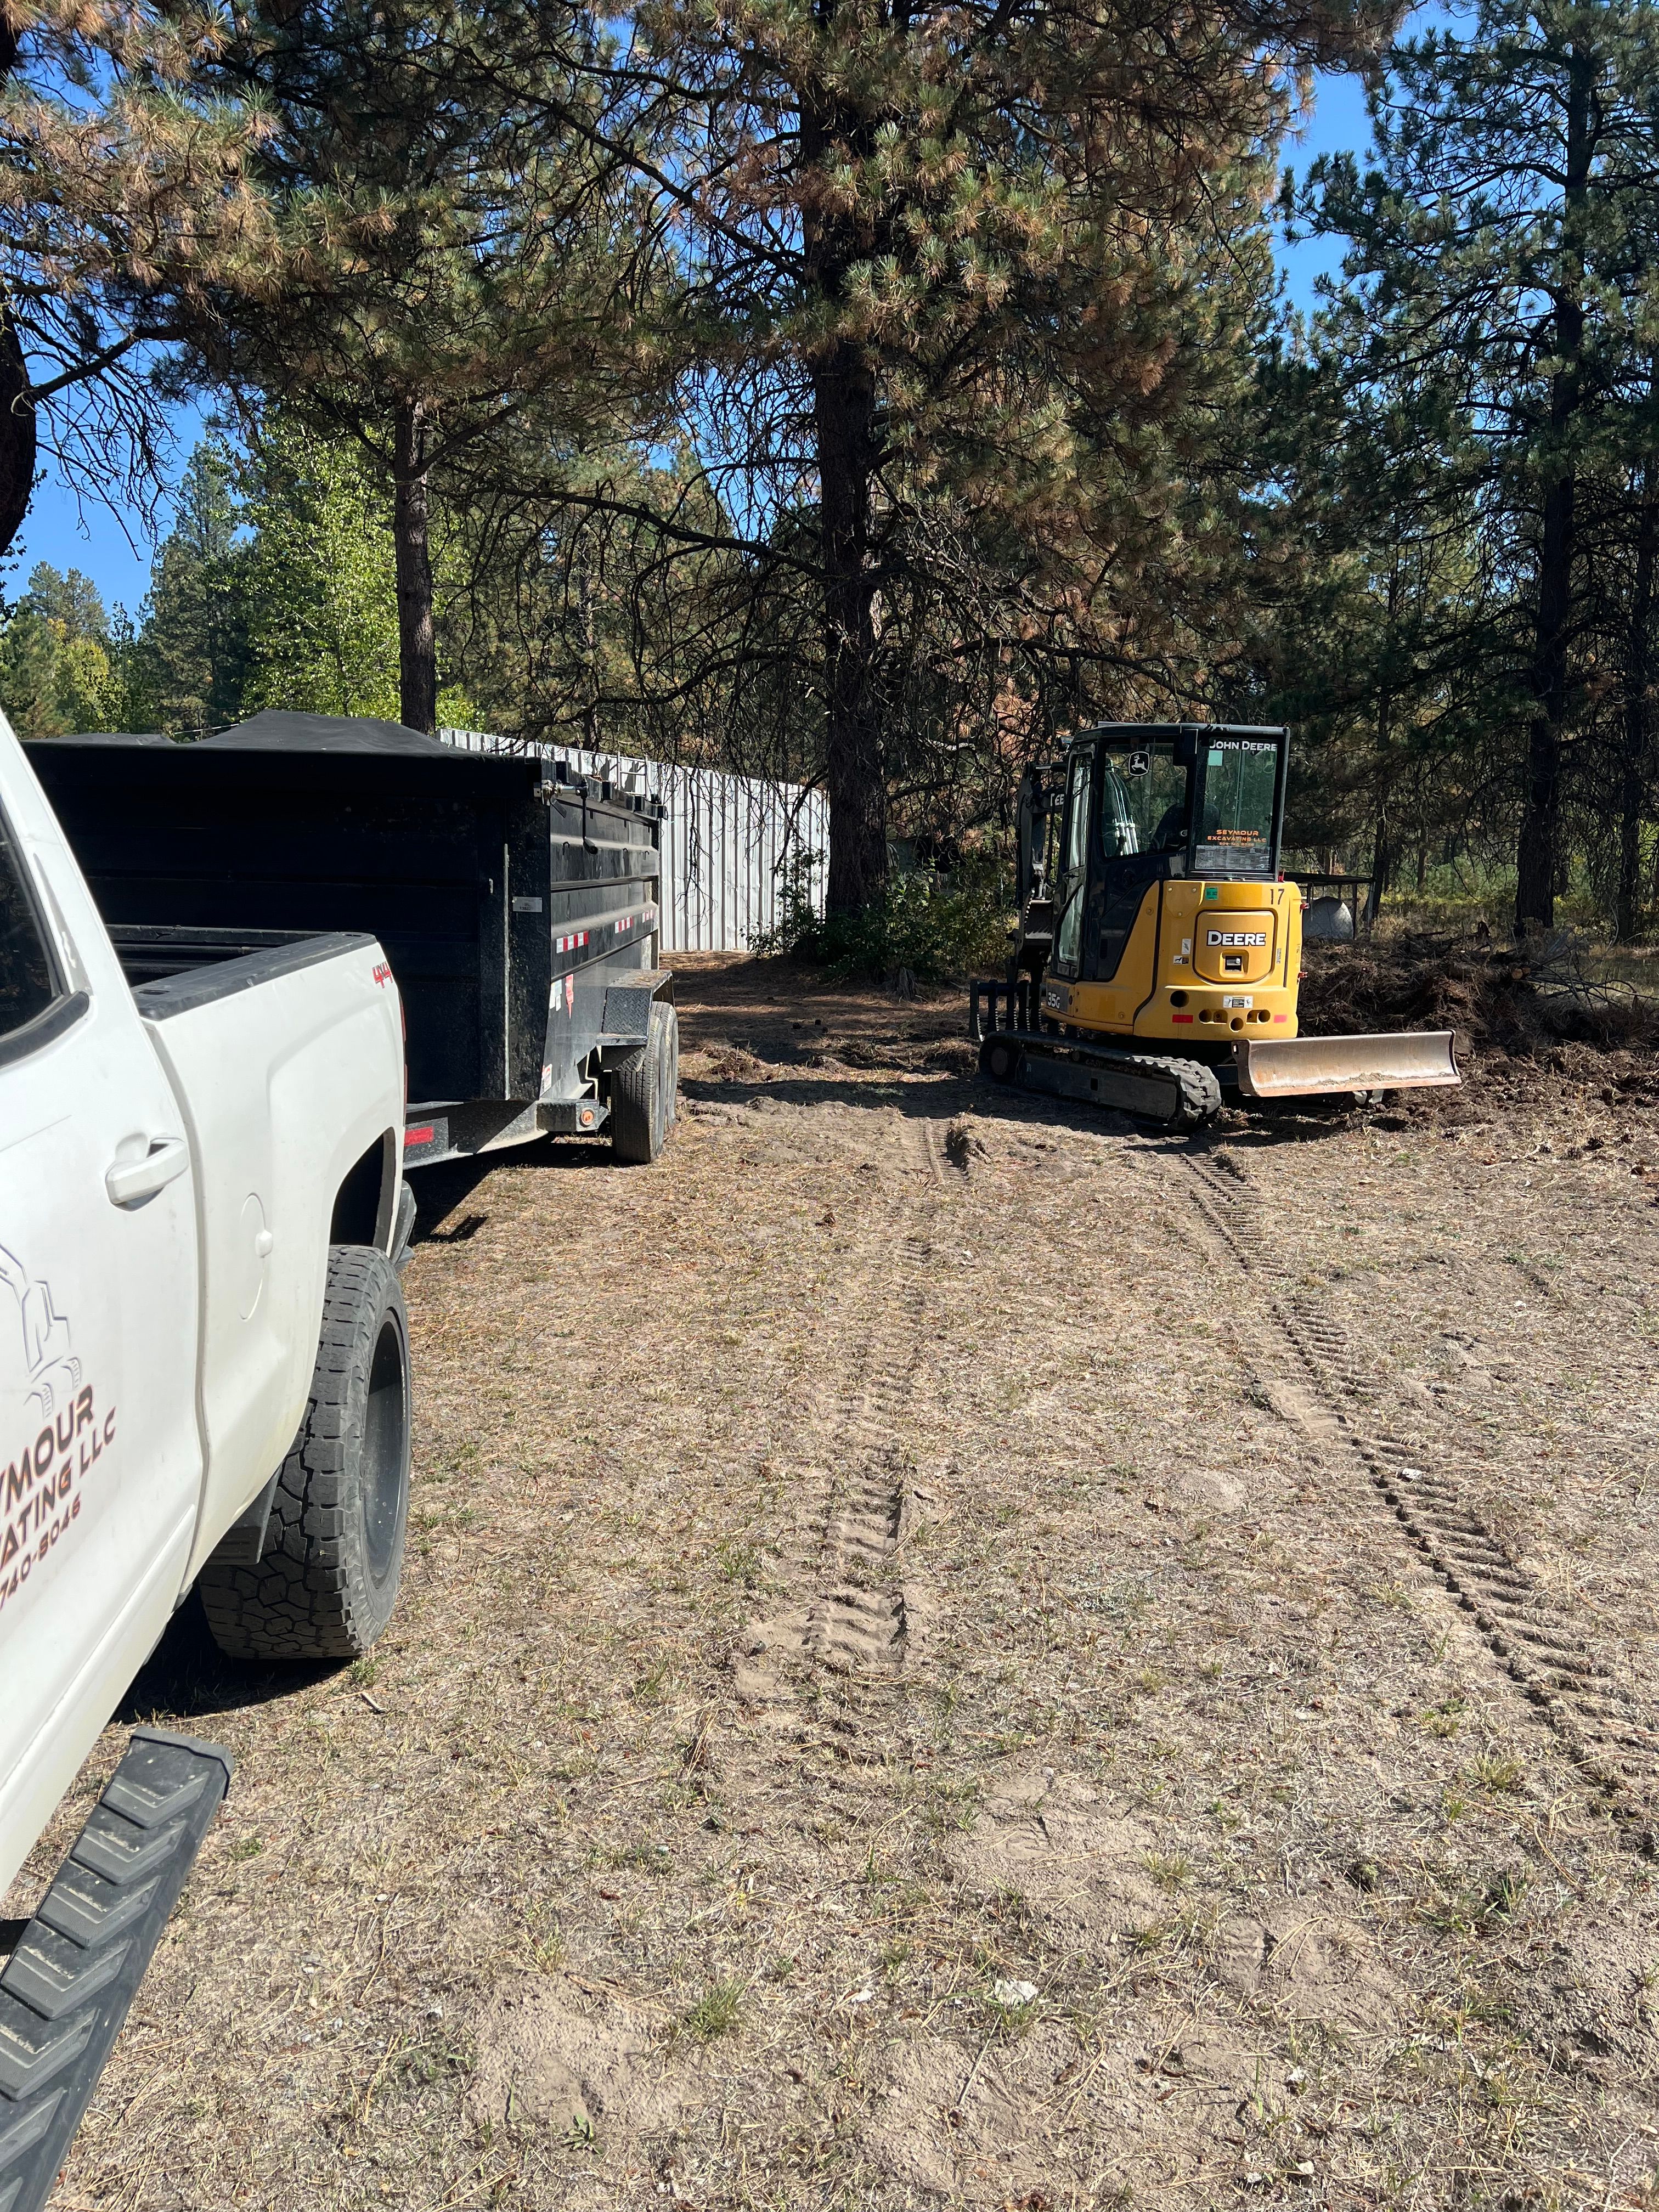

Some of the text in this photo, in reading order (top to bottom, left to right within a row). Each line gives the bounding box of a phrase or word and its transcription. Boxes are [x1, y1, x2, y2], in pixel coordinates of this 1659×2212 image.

[1209, 740, 1277, 751] JOHN DEERE
[1270, 889, 1285, 905] 17
[1207, 930, 1266, 946] DEERE
[1047, 992, 1060, 1009] 35G
[0, 1406, 116, 1571] ATING LLC
